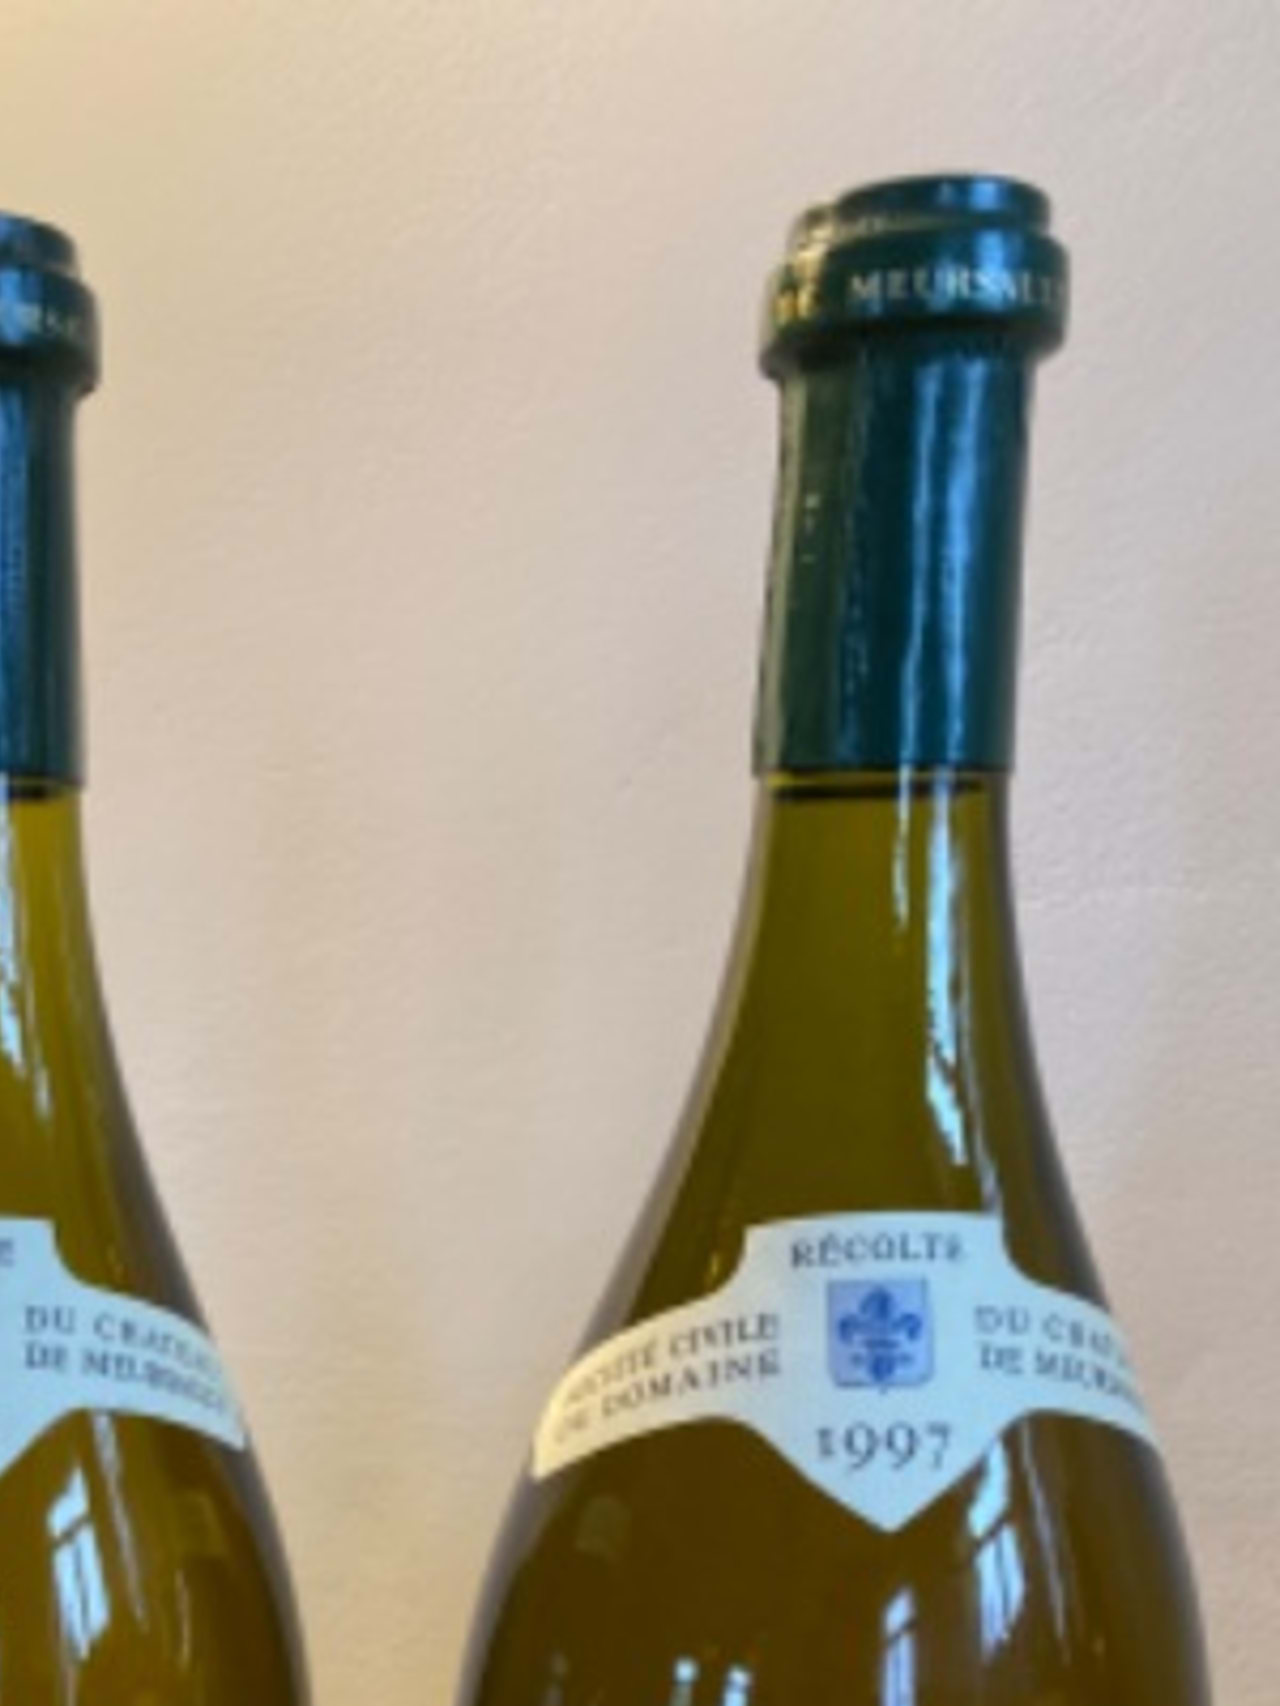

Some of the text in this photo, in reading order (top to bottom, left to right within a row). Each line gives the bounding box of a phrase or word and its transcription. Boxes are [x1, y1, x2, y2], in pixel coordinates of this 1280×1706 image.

[790, 1232, 966, 1271] RÉCOLTE
[24, 1304, 77, 1336] DU
[669, 1312, 780, 1359] CIVILE
[974, 1304, 1031, 1336] DU
[24, 1342, 68, 1374] DE
[980, 1342, 1024, 1376] DE
[601, 1348, 782, 1418] DOMAINE
[817, 1422, 953, 1472] 1997
